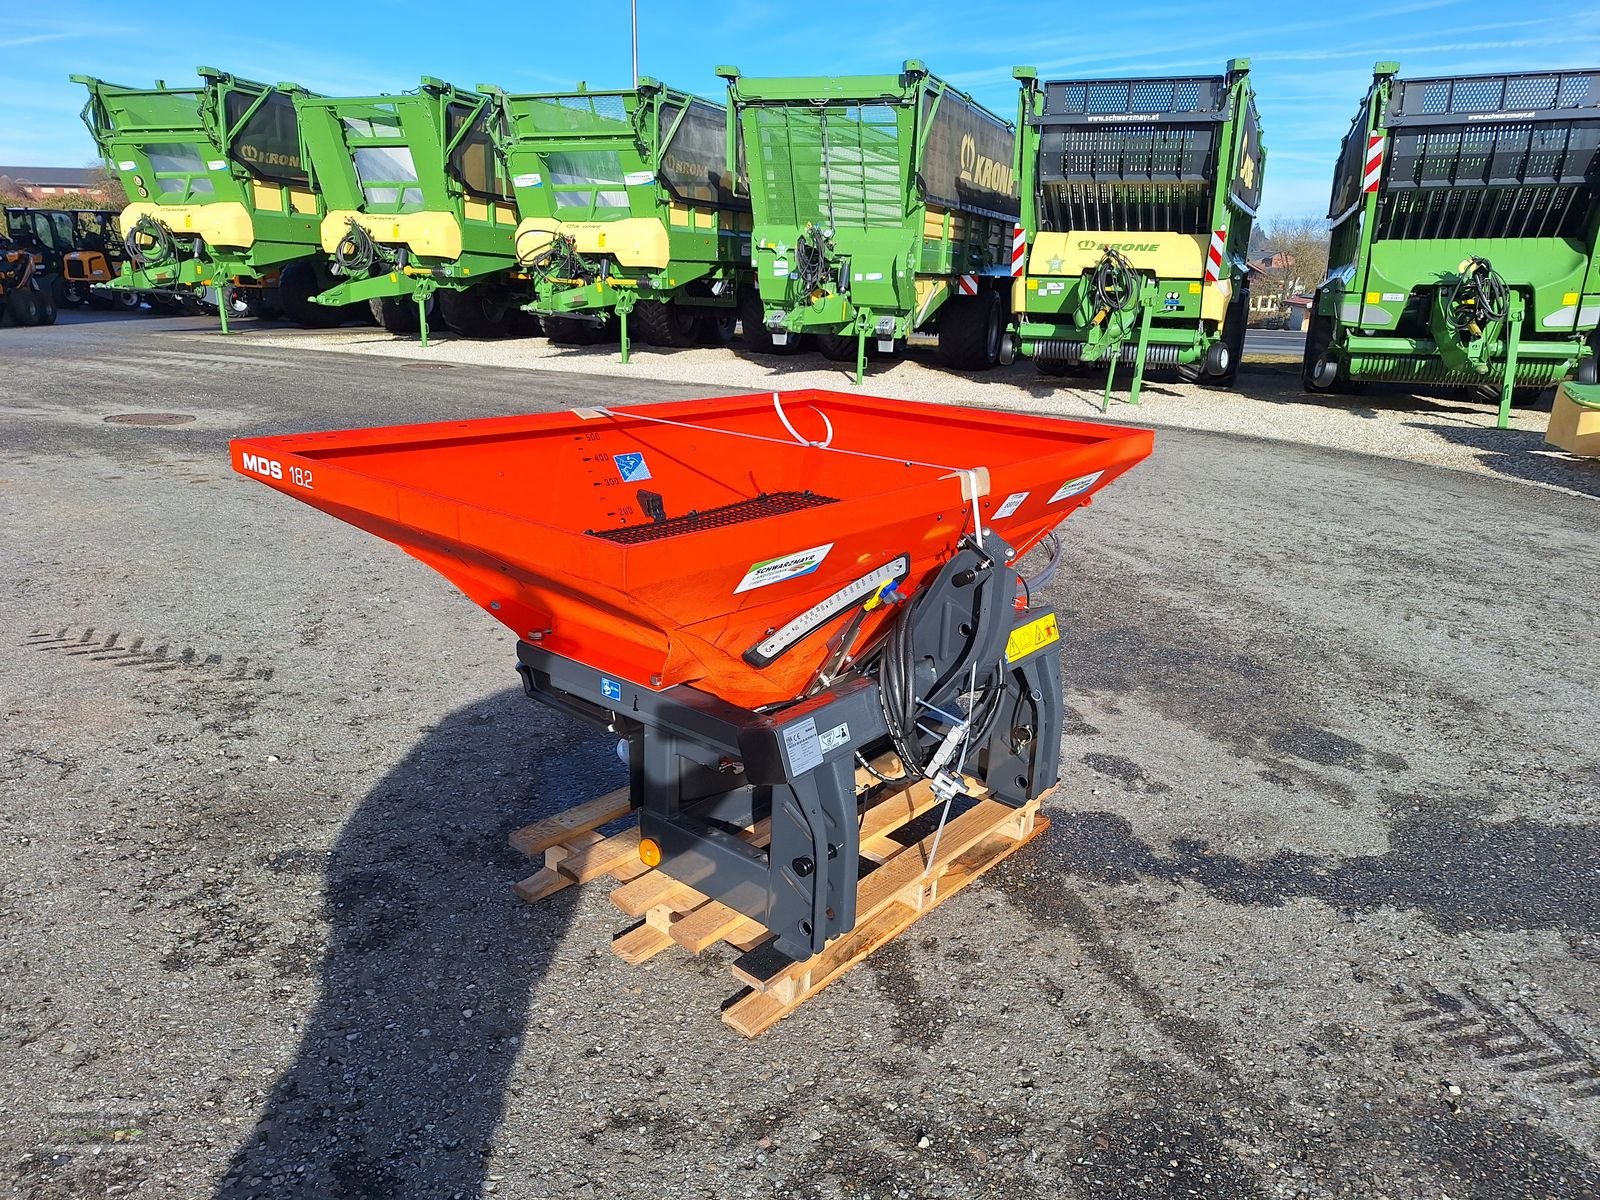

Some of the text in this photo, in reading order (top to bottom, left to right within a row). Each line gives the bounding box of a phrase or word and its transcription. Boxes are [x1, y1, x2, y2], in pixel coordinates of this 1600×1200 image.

[1087, 113, 1159, 122] www.schwarzmayr.at
[1468, 111, 1535, 120] www.schwarzmayr.at
[585, 432, 601, 442] 500
[594, 453, 609, 462] 400
[242, 452, 314, 490] MDS 18.2
[604, 477, 620, 487] 300
[618, 506, 634, 516] 200
[754, 554, 816, 576] SCHWARZMAYR
